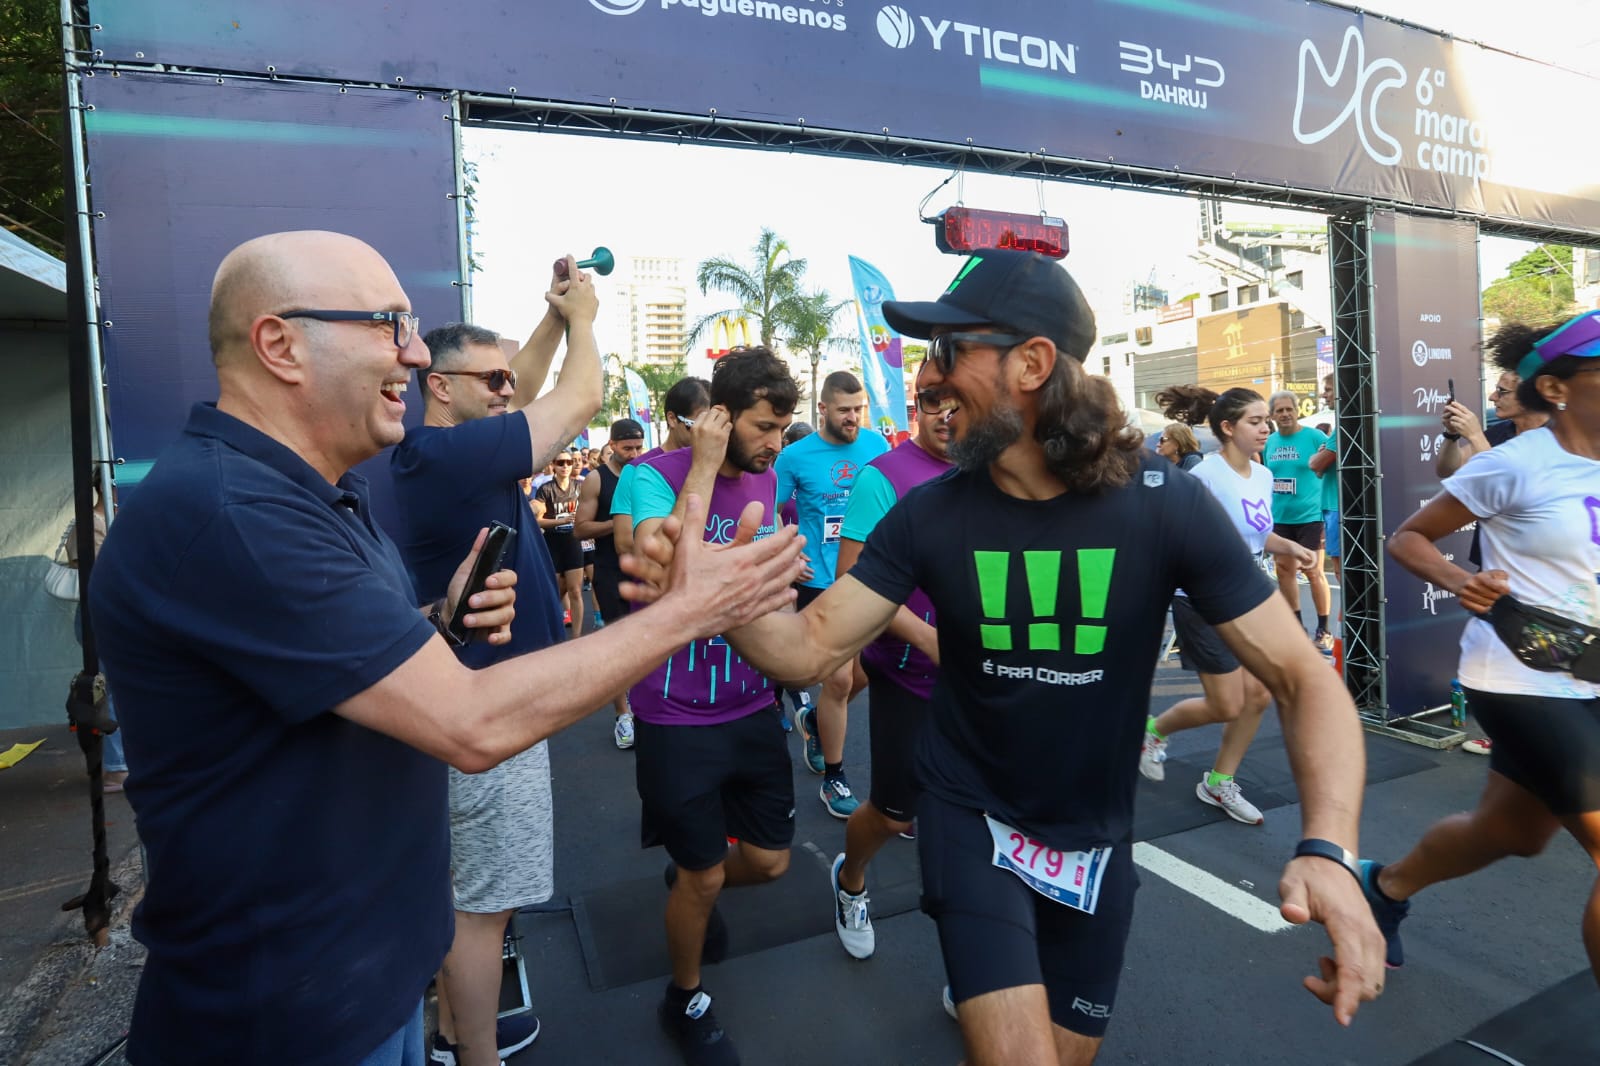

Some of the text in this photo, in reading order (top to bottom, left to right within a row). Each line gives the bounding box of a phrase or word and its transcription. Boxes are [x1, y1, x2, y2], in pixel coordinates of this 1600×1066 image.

[920, 15, 1077, 74] YTICON
[1118, 40, 1226, 88] BYD
[1140, 80, 1208, 110] DAHRUJ
[1419, 313, 1442, 323] APOIO
[983, 659, 1104, 686] É PRA CORRER
[1009, 832, 1064, 878] 279
